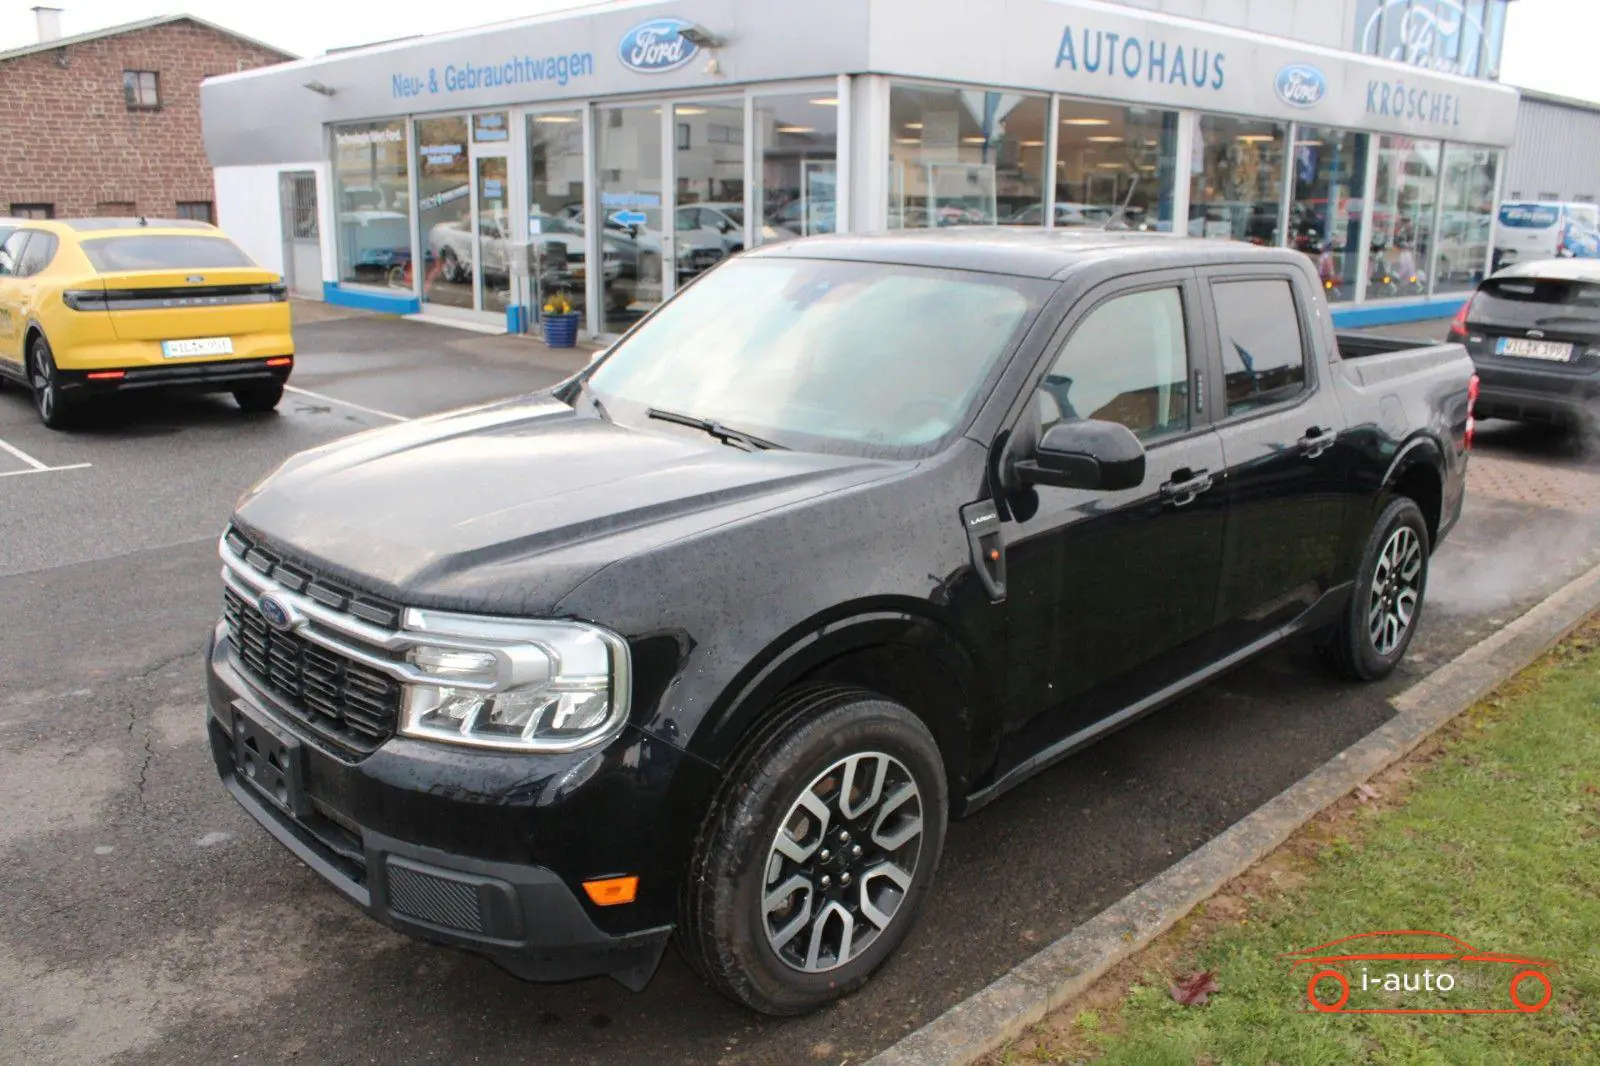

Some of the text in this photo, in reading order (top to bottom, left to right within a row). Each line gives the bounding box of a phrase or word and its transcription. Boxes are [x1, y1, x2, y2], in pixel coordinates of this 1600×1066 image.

[630, 27, 686, 66] Ford
[1054, 25, 1226, 91] AUTOHAUS
[391, 51, 593, 99] Neu- & Gebrauchtwagen
[1283, 70, 1320, 102] Ford
[1365, 78, 1460, 127] KRÖSCHEL
